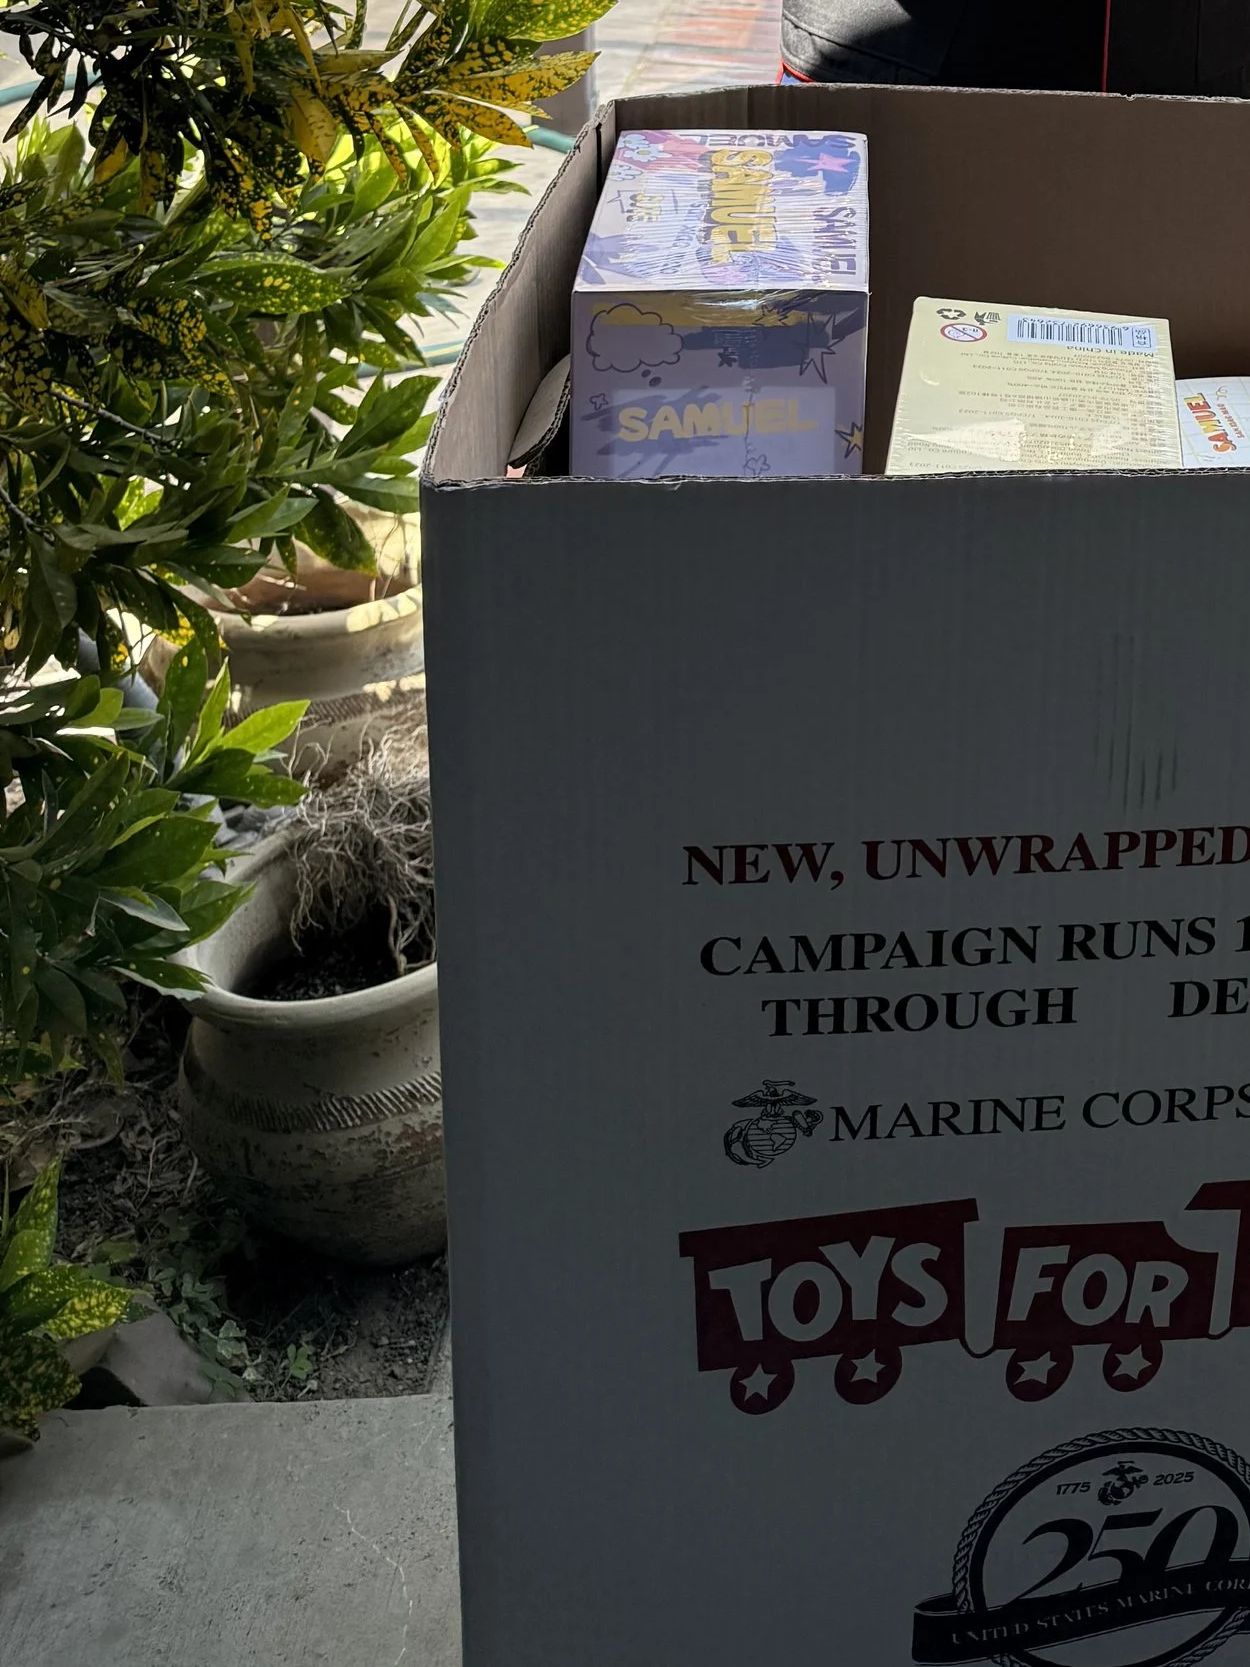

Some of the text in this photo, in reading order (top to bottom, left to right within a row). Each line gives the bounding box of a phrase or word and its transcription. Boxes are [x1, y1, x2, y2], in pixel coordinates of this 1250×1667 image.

[704, 149, 778, 265] SAMUEL
[1121, 349, 1155, 358] Made
[617, 400, 820, 442] SAMUEL
[1184, 392, 1237, 453] SAMUEL
[682, 842, 844, 890] NEW,
[699, 925, 1042, 976] CAMPAIGN
[1056, 916, 1216, 962] RUNS
[761, 987, 1079, 1037] THROUGH
[828, 1095, 1067, 1142] MARINE
[708, 1235, 948, 1342] TOYS
[1007, 1244, 1189, 1327] FOR
[1056, 1471, 1195, 1496] 1775 2025
[1021, 1505, 1239, 1605] 250
[952, 1621, 1030, 1646] UNITED
[1037, 1602, 1109, 1629] STATES
[1116, 1582, 1194, 1610] MARINE
